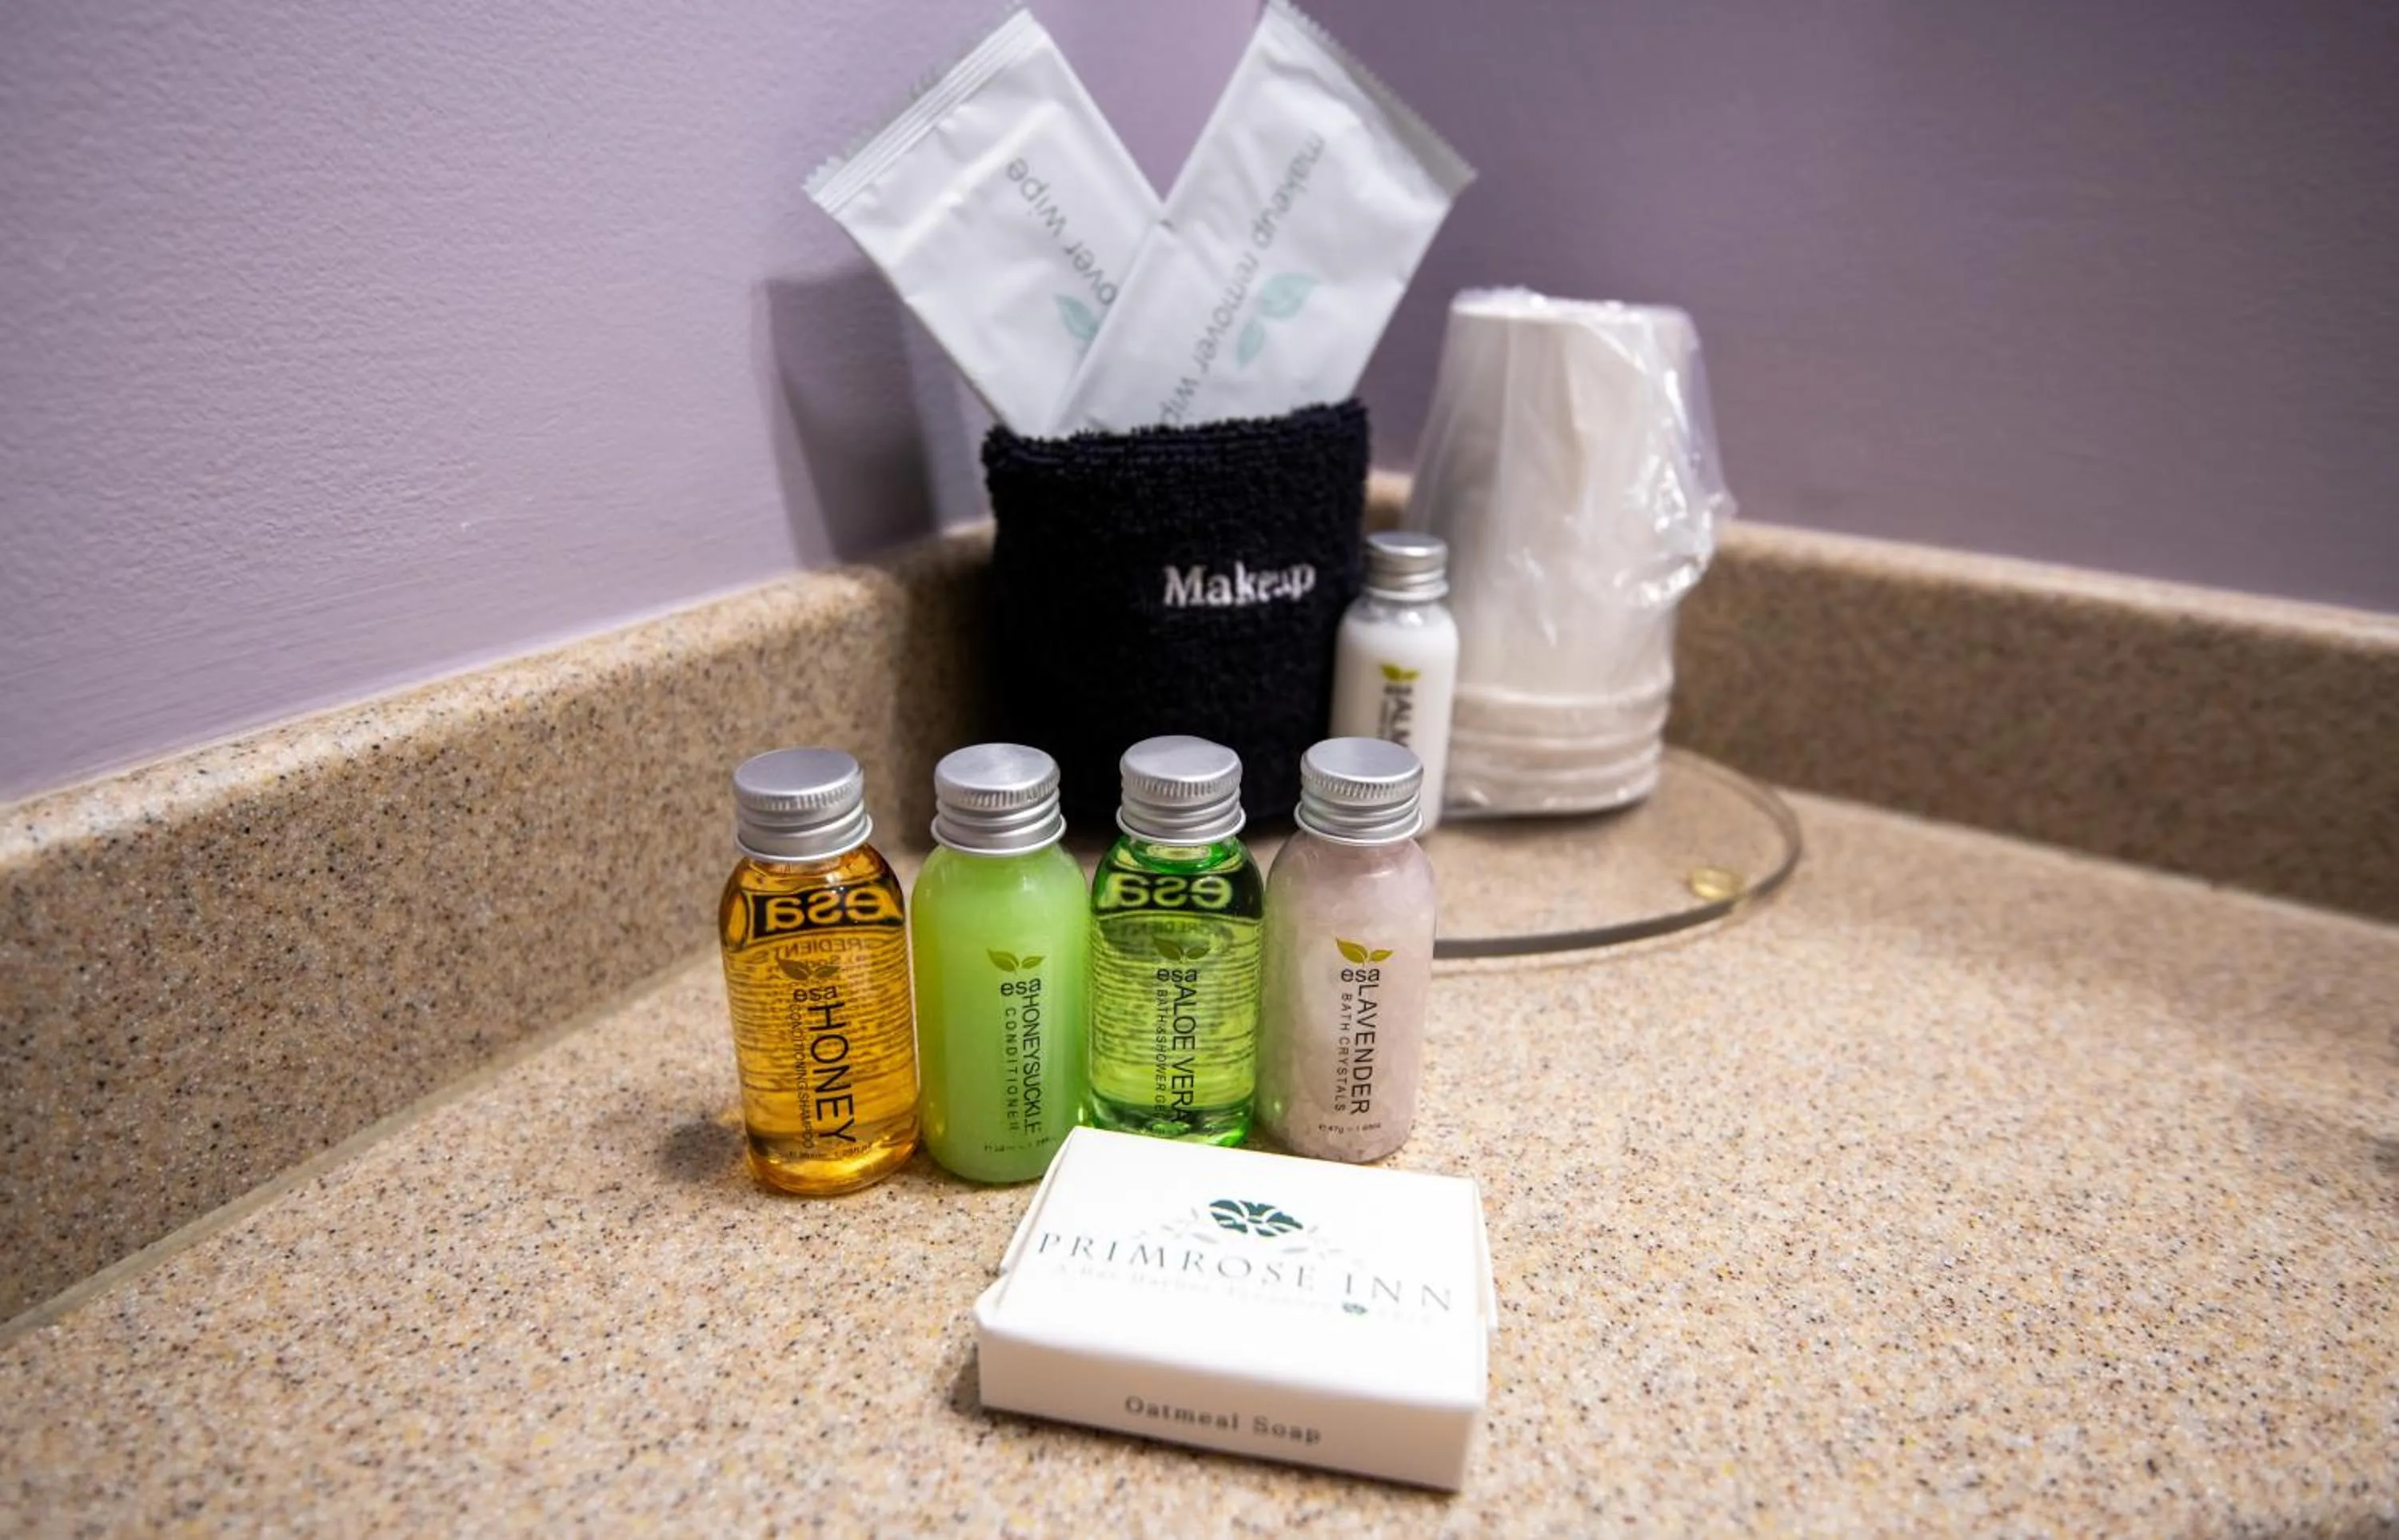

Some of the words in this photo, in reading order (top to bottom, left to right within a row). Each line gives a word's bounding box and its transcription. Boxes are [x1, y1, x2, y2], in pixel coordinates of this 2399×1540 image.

[1005, 158, 1068, 237] wipe
[1251, 130, 1326, 249] makeup
[1061, 240, 1119, 306] over
[1192, 250, 1259, 374] remover
[1161, 376, 1200, 425] wip
[1164, 559, 1317, 608] Makeup
[792, 985, 838, 1003] esa
[1000, 977, 1041, 998] esa
[1156, 967, 1198, 983] esa
[1341, 967, 1379, 983] esa
[1172, 984, 1199, 1051] ALOE
[1339, 992, 1353, 1031] BATH
[807, 999, 857, 1143] HONEY
[1023, 994, 1042, 1135] HONEYSUCKLE
[1333, 1035, 1351, 1113] CRYSTALS
[1349, 983, 1380, 1116] LAVENDER
[1171, 1055, 1196, 1123] VERA
[1038, 1232, 1316, 1291] PRIMROSE
[1345, 1273, 1451, 1311] INN
[1124, 1395, 1239, 1431] Oatmeal
[1252, 1414, 1322, 1446] Soap
